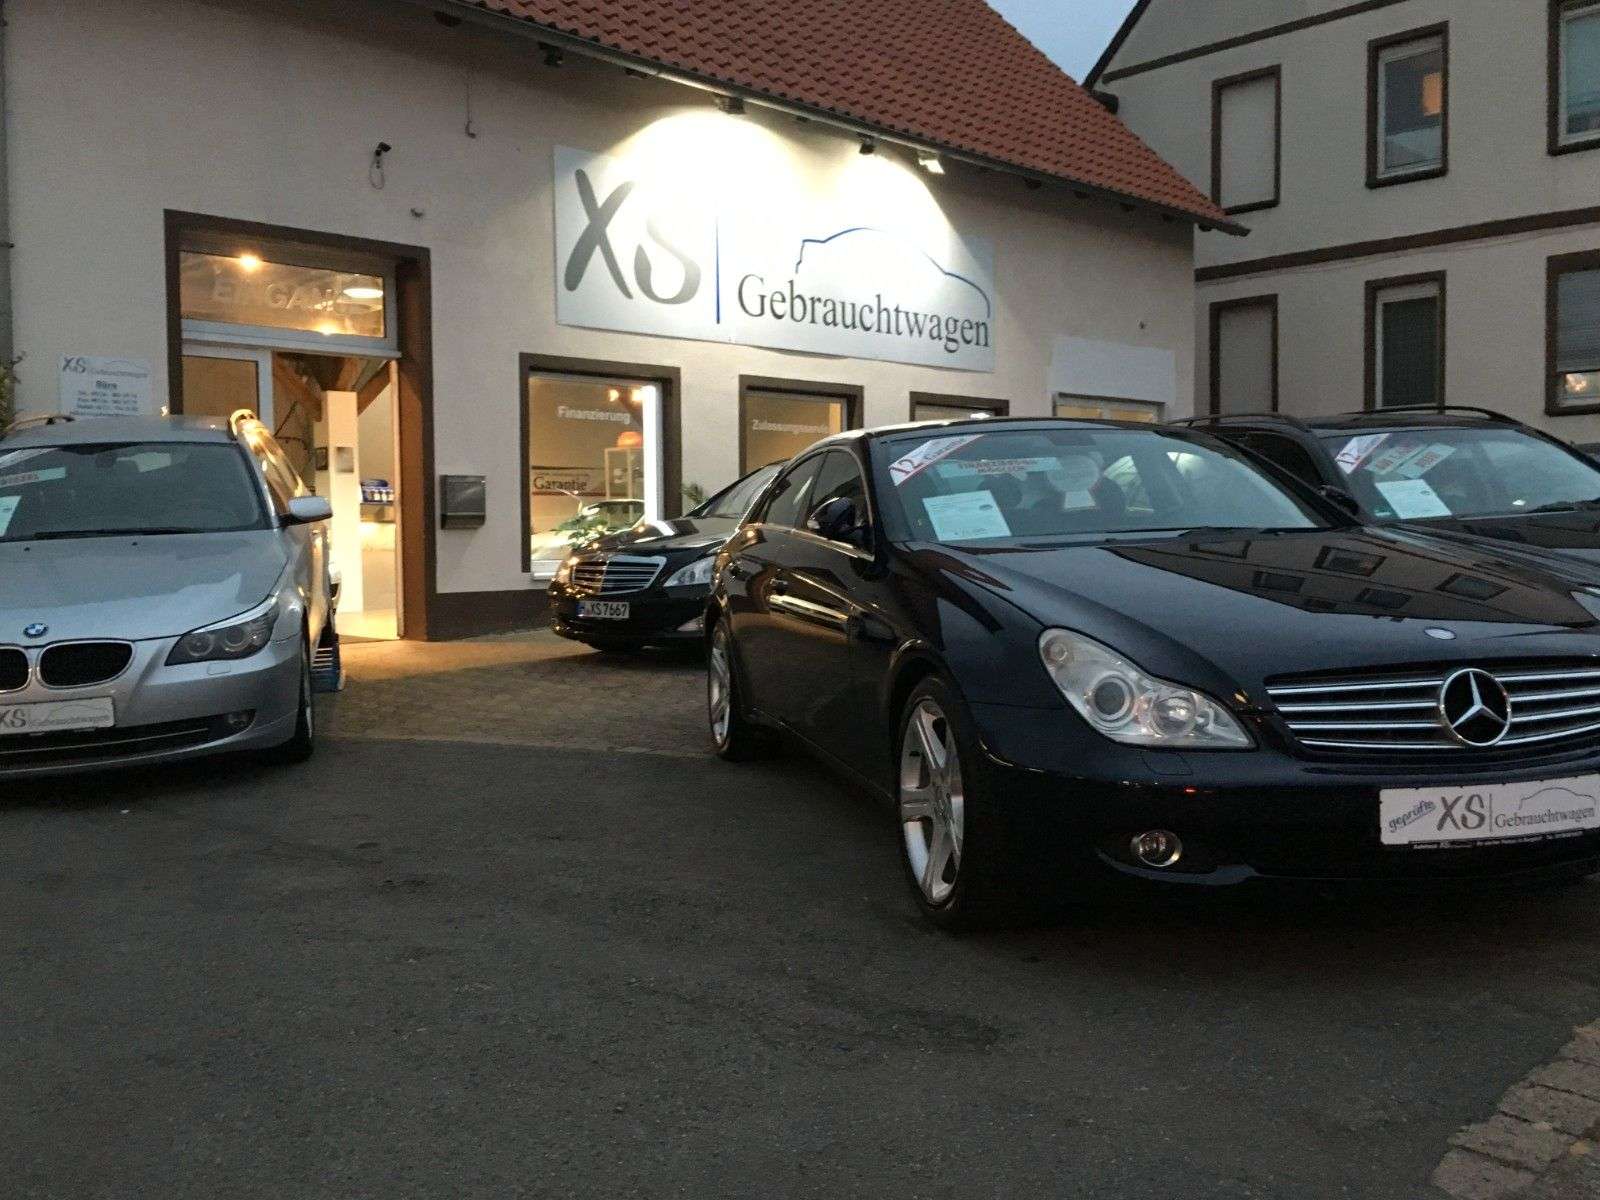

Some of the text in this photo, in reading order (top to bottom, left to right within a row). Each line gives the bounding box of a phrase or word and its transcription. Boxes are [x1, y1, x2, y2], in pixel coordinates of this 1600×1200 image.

[564, 168, 701, 305] XS
[737, 272, 991, 353] Gebrauchtwagen
[557, 405, 631, 425] Finanzierung
[534, 476, 588, 491] Garantie
[1437, 794, 1596, 832] XS Gebrauchtwagen
